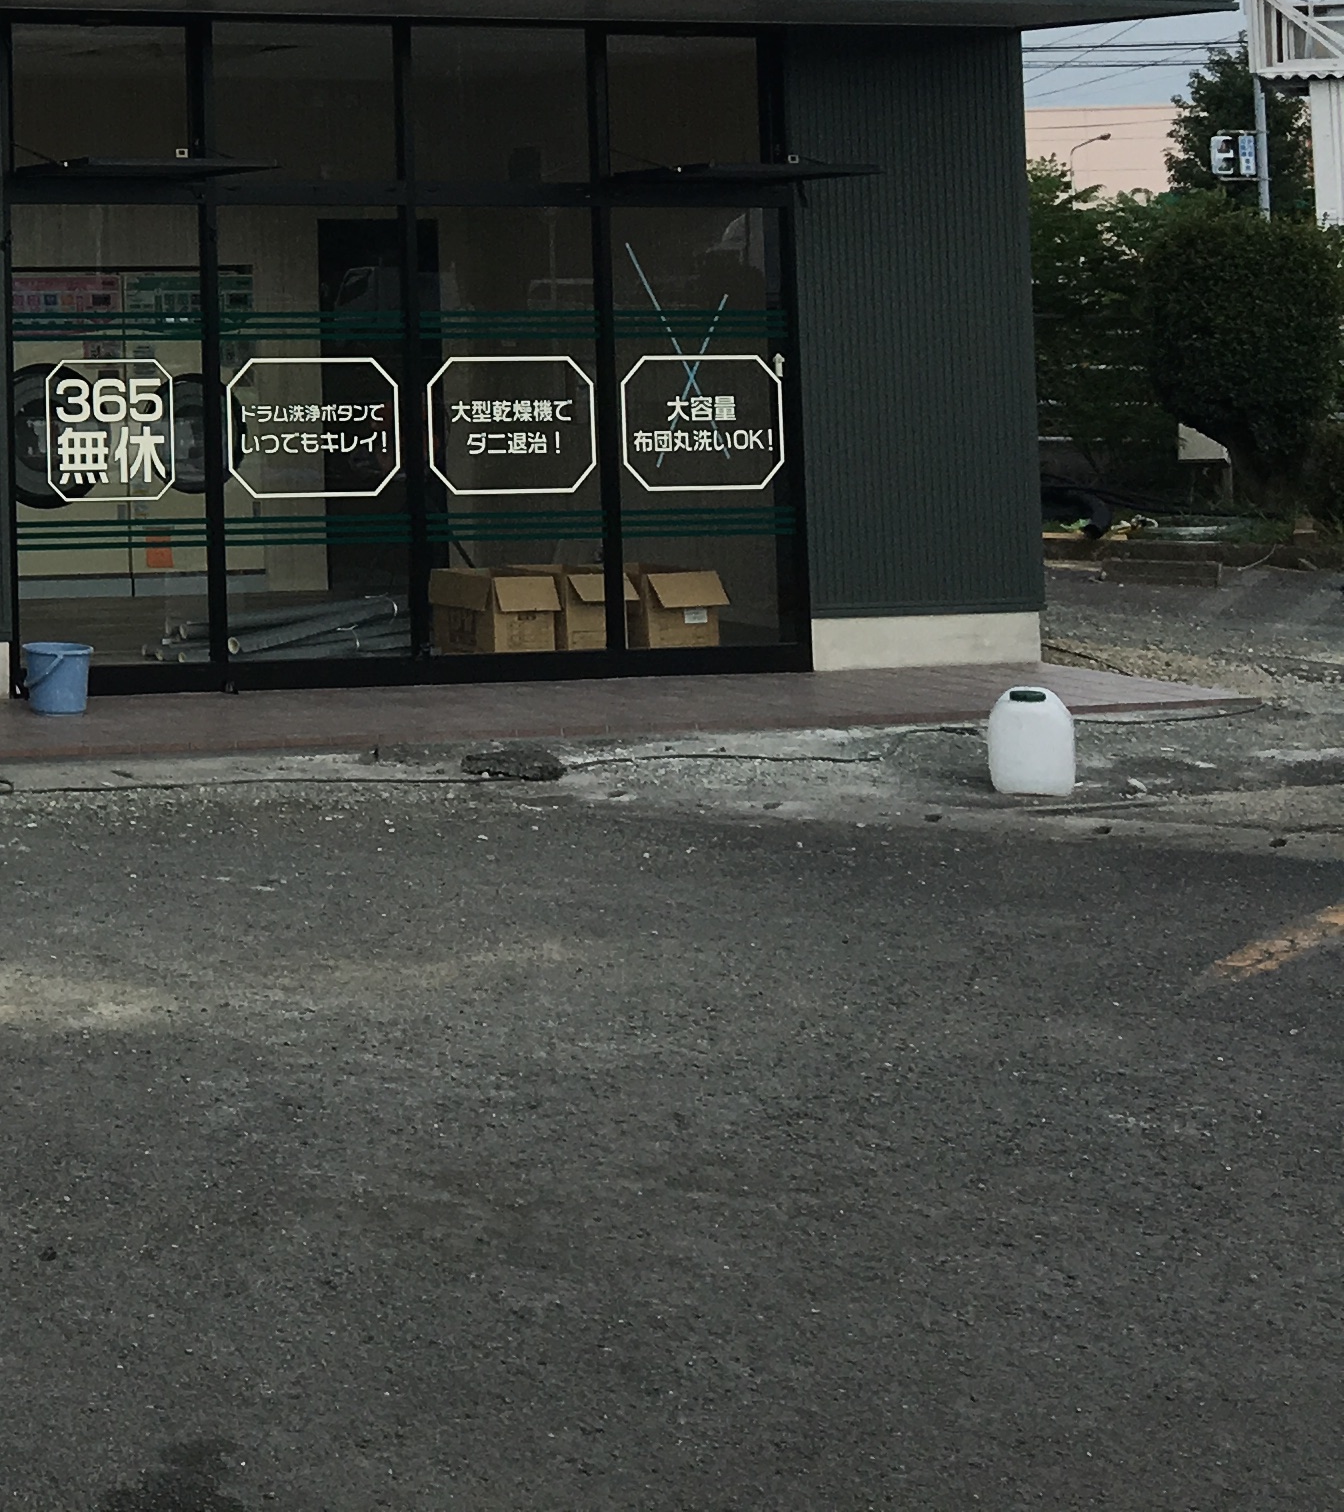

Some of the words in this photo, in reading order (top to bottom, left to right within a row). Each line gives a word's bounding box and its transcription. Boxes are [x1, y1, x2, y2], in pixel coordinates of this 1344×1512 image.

[55, 378, 163, 423] 365
[241, 403, 385, 423] ドラム洗浄ボタンで
[451, 399, 573, 423] 大型乾燥機で
[666, 395, 737, 422] 大容量
[241, 430, 387, 454] いつでもキレイ!
[466, 430, 561, 455] ダニ退治！
[633, 428, 774, 453] 布団丸洗いOK!
[57, 425, 167, 485] 無休
